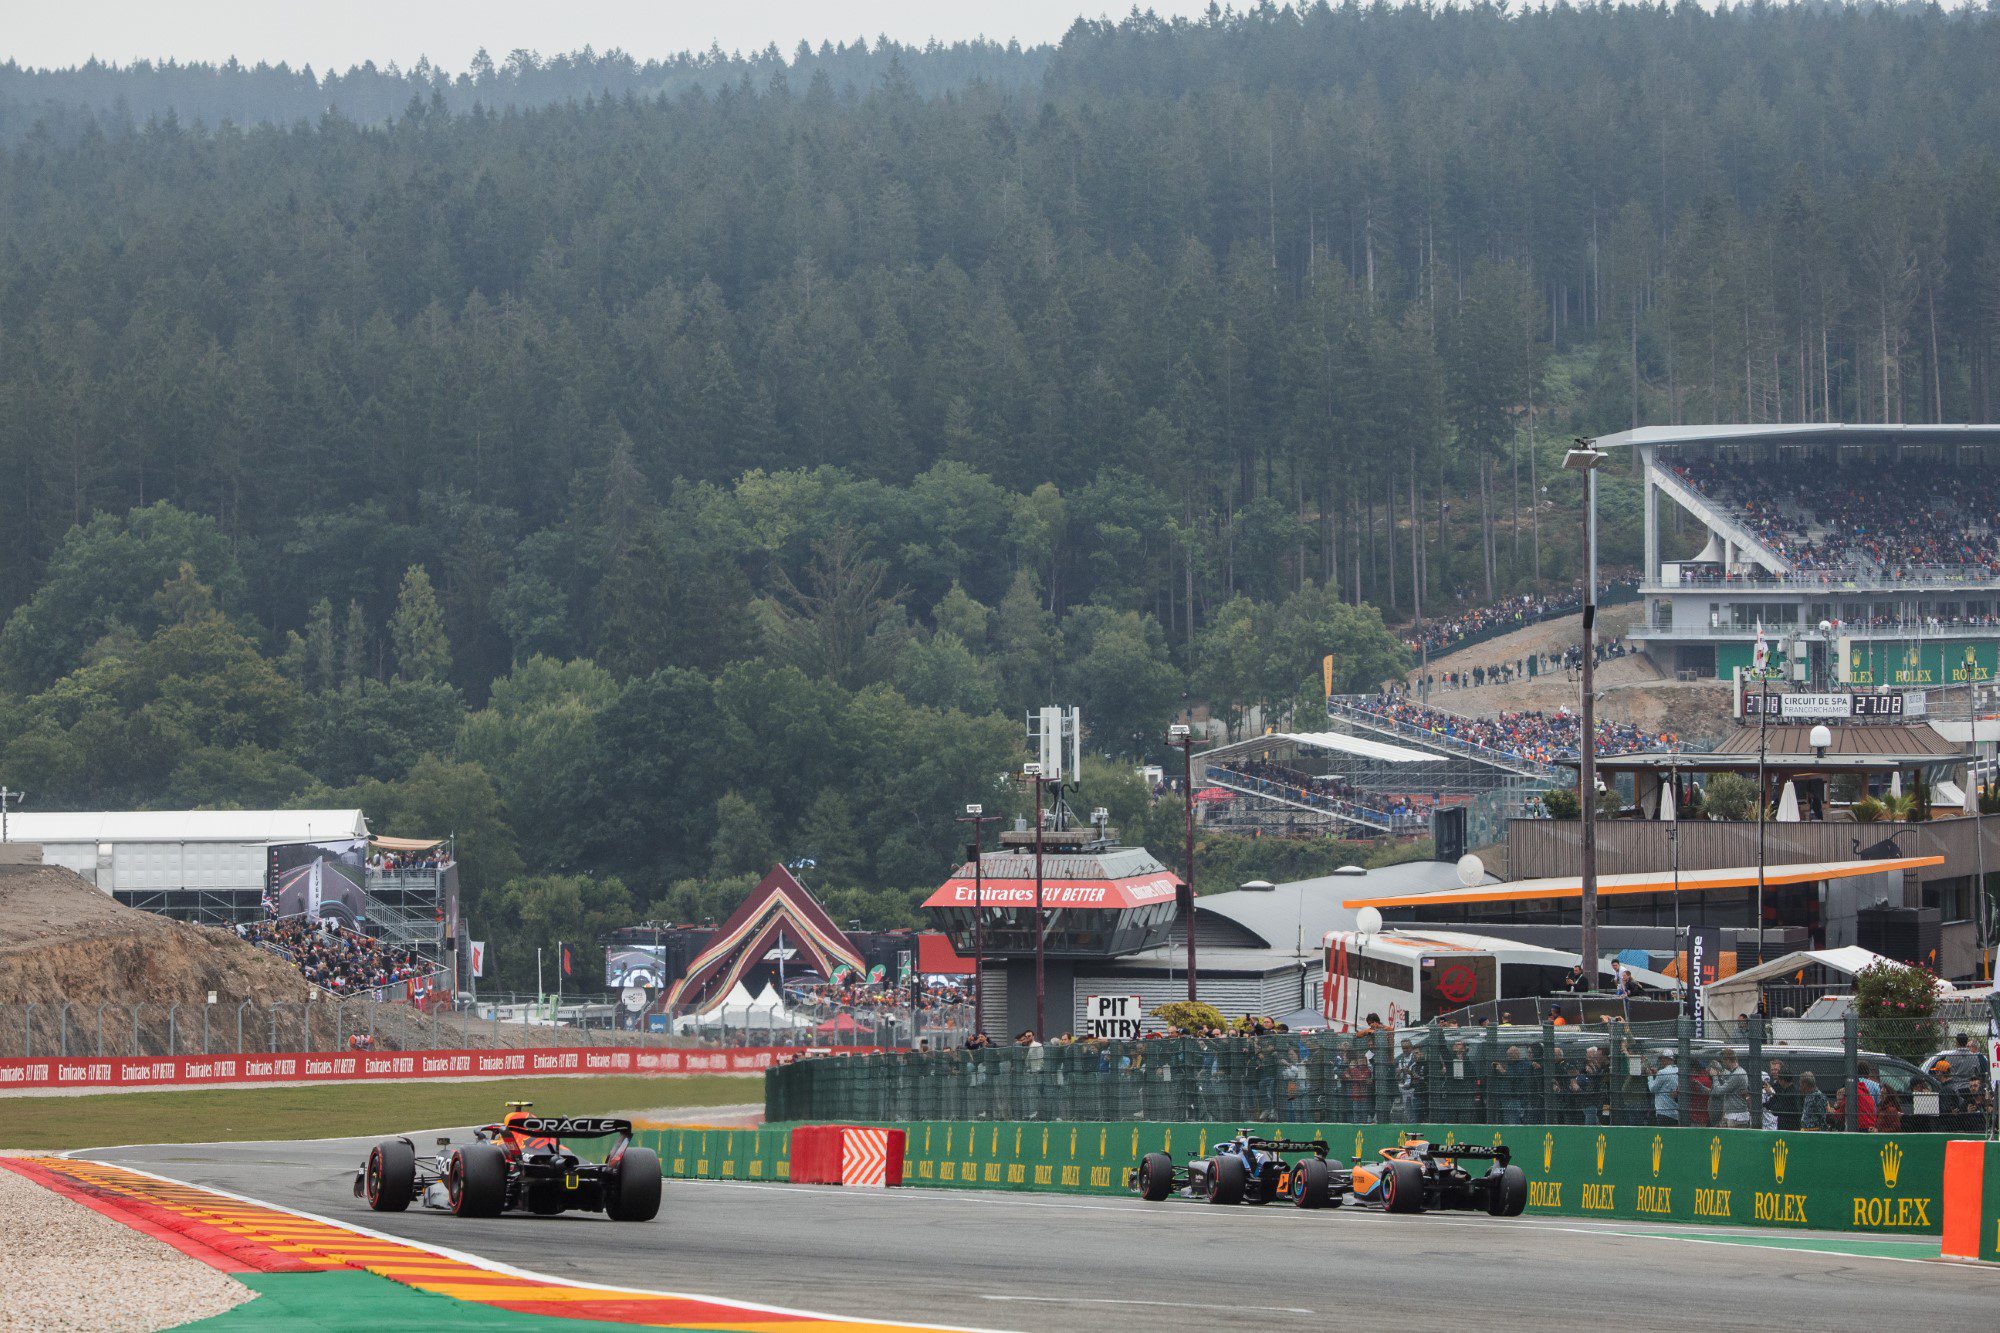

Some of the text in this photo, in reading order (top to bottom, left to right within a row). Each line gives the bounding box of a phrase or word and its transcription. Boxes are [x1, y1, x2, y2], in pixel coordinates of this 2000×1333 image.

[1895, 669, 1931, 683] ROLEX
[1952, 667, 1988, 681] ROLEX
[1784, 697, 1849, 706] CIRCUIT DE SPA
[1855, 696, 1902, 714] 27.08
[955, 886, 1106, 902] Emirates FLY BETTER
[1099, 998, 1129, 1017] PIT
[1087, 1019, 1141, 1039] ENTRY
[523, 1119, 616, 1132] ORACLE
[1529, 1182, 1563, 1207] ROLEX
[1582, 1184, 1615, 1211] ROLEX
[1637, 1186, 1671, 1213] ROLEX
[1694, 1189, 1731, 1217] ROLEX
[1755, 1191, 1808, 1223] ROLEX
[1852, 1197, 1932, 1226] ROLEX
